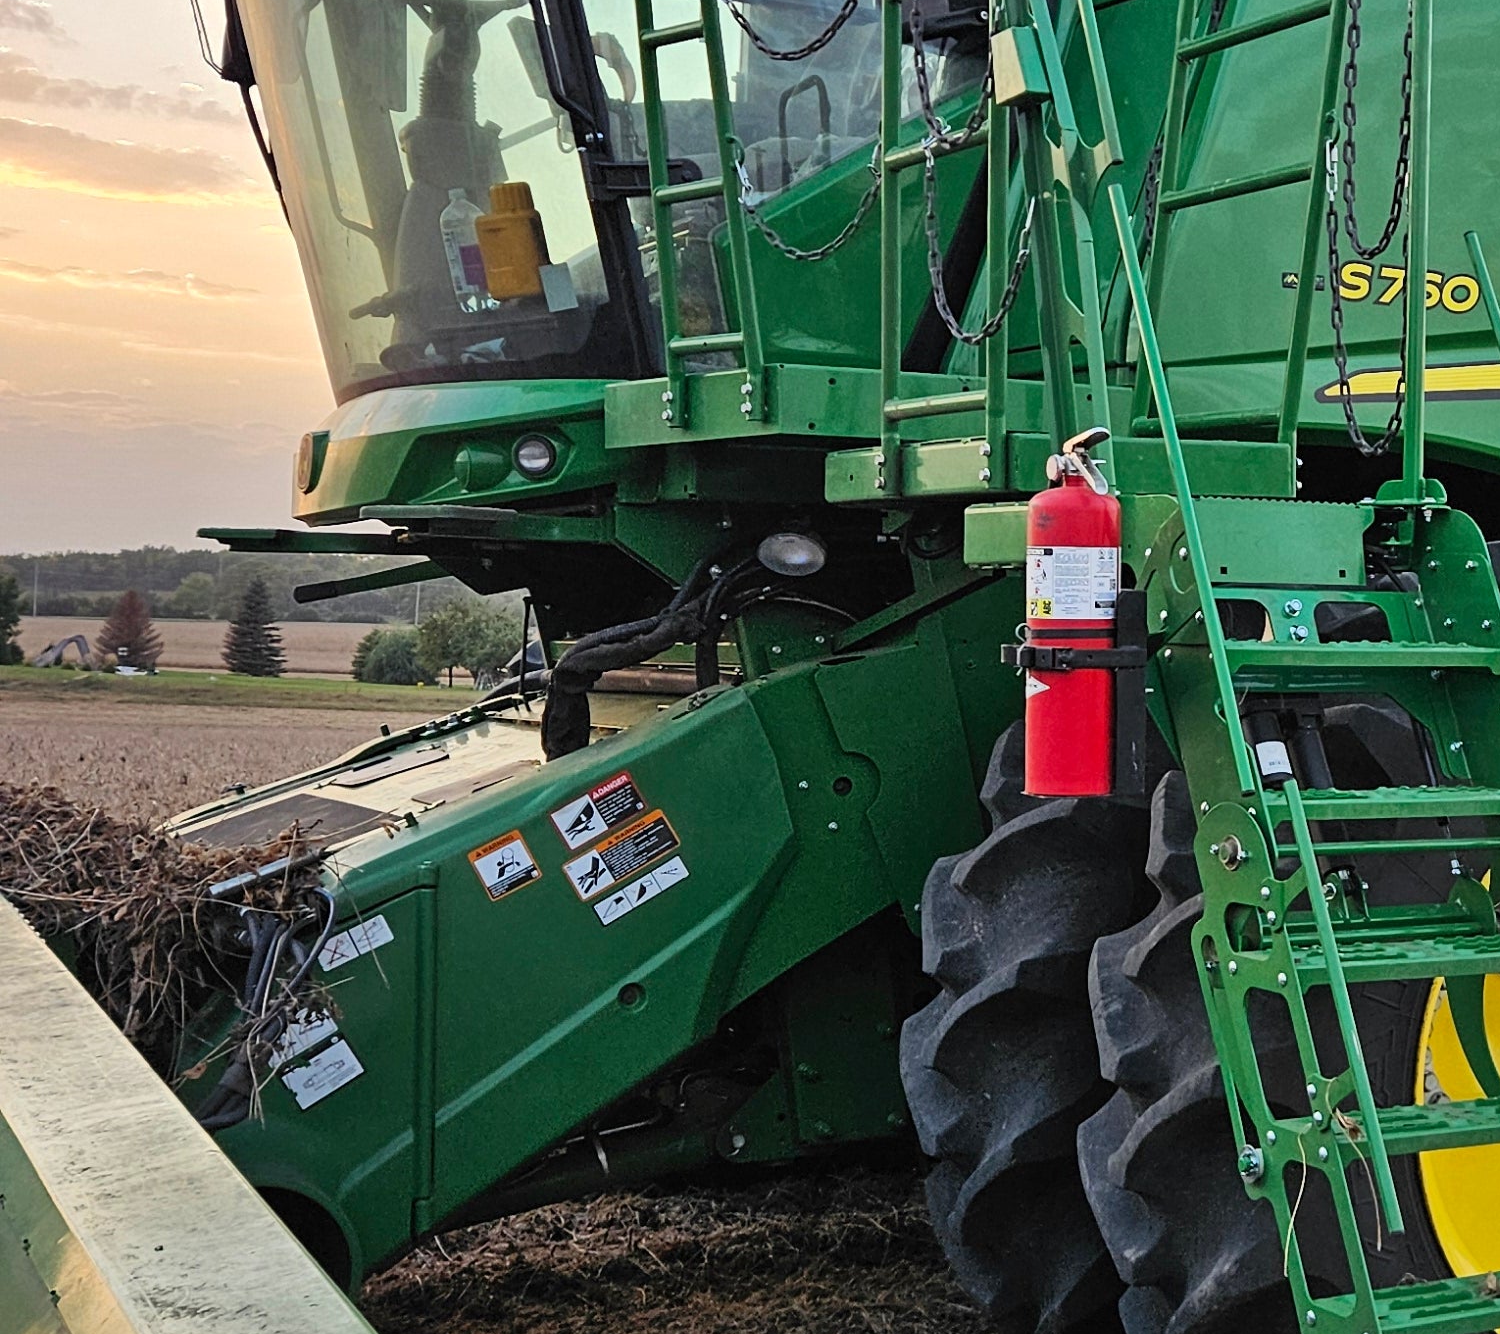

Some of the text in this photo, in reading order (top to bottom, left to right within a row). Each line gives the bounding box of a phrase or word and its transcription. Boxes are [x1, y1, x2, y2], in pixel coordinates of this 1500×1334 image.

[597, 774, 629, 796] DANGER
[614, 820, 646, 841] WARNING
[482, 834, 514, 854] WARNING
